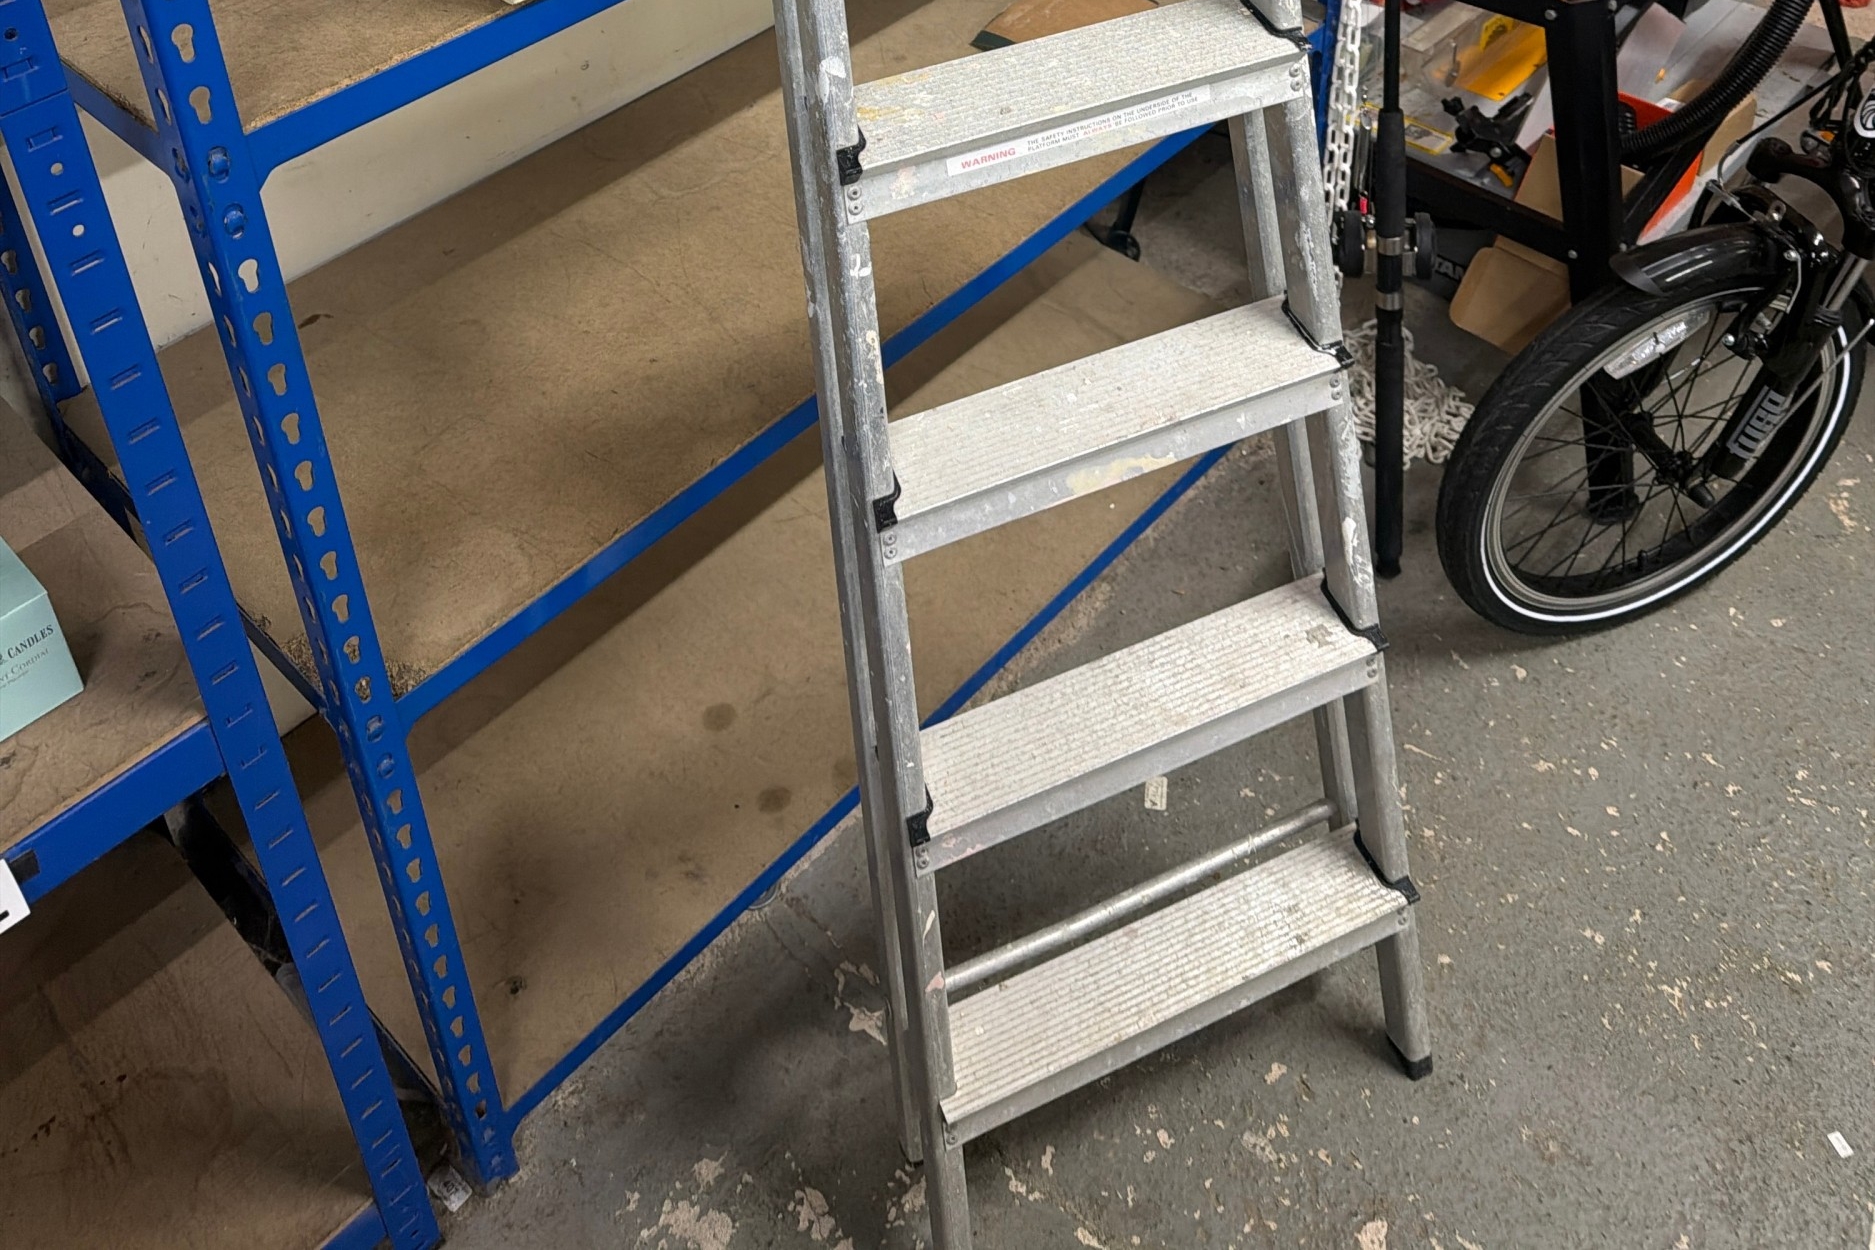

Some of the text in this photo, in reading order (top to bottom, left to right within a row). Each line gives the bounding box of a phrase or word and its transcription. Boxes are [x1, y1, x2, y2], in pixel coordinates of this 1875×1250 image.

[1027, 138, 1039, 146] THE
[1041, 131, 1065, 142] SAFETY
[1066, 117, 1111, 135] INSTRUCTIONS
[1123, 109, 1135, 117] THE
[1136, 99, 1170, 113] UNDERSIDE
[1027, 138, 1061, 151] PLATFORM
[1062, 132, 1080, 141] MUST
[1082, 124, 1113, 136] ALWAYS
[1124, 108, 1157, 123] FOLLOWED
[1157, 104, 1176, 113] PRIOR
[1186, 96, 1199, 104] USE
[961, 147, 1016, 169] WARNING
[7, 624, 54, 659] CANDLES
